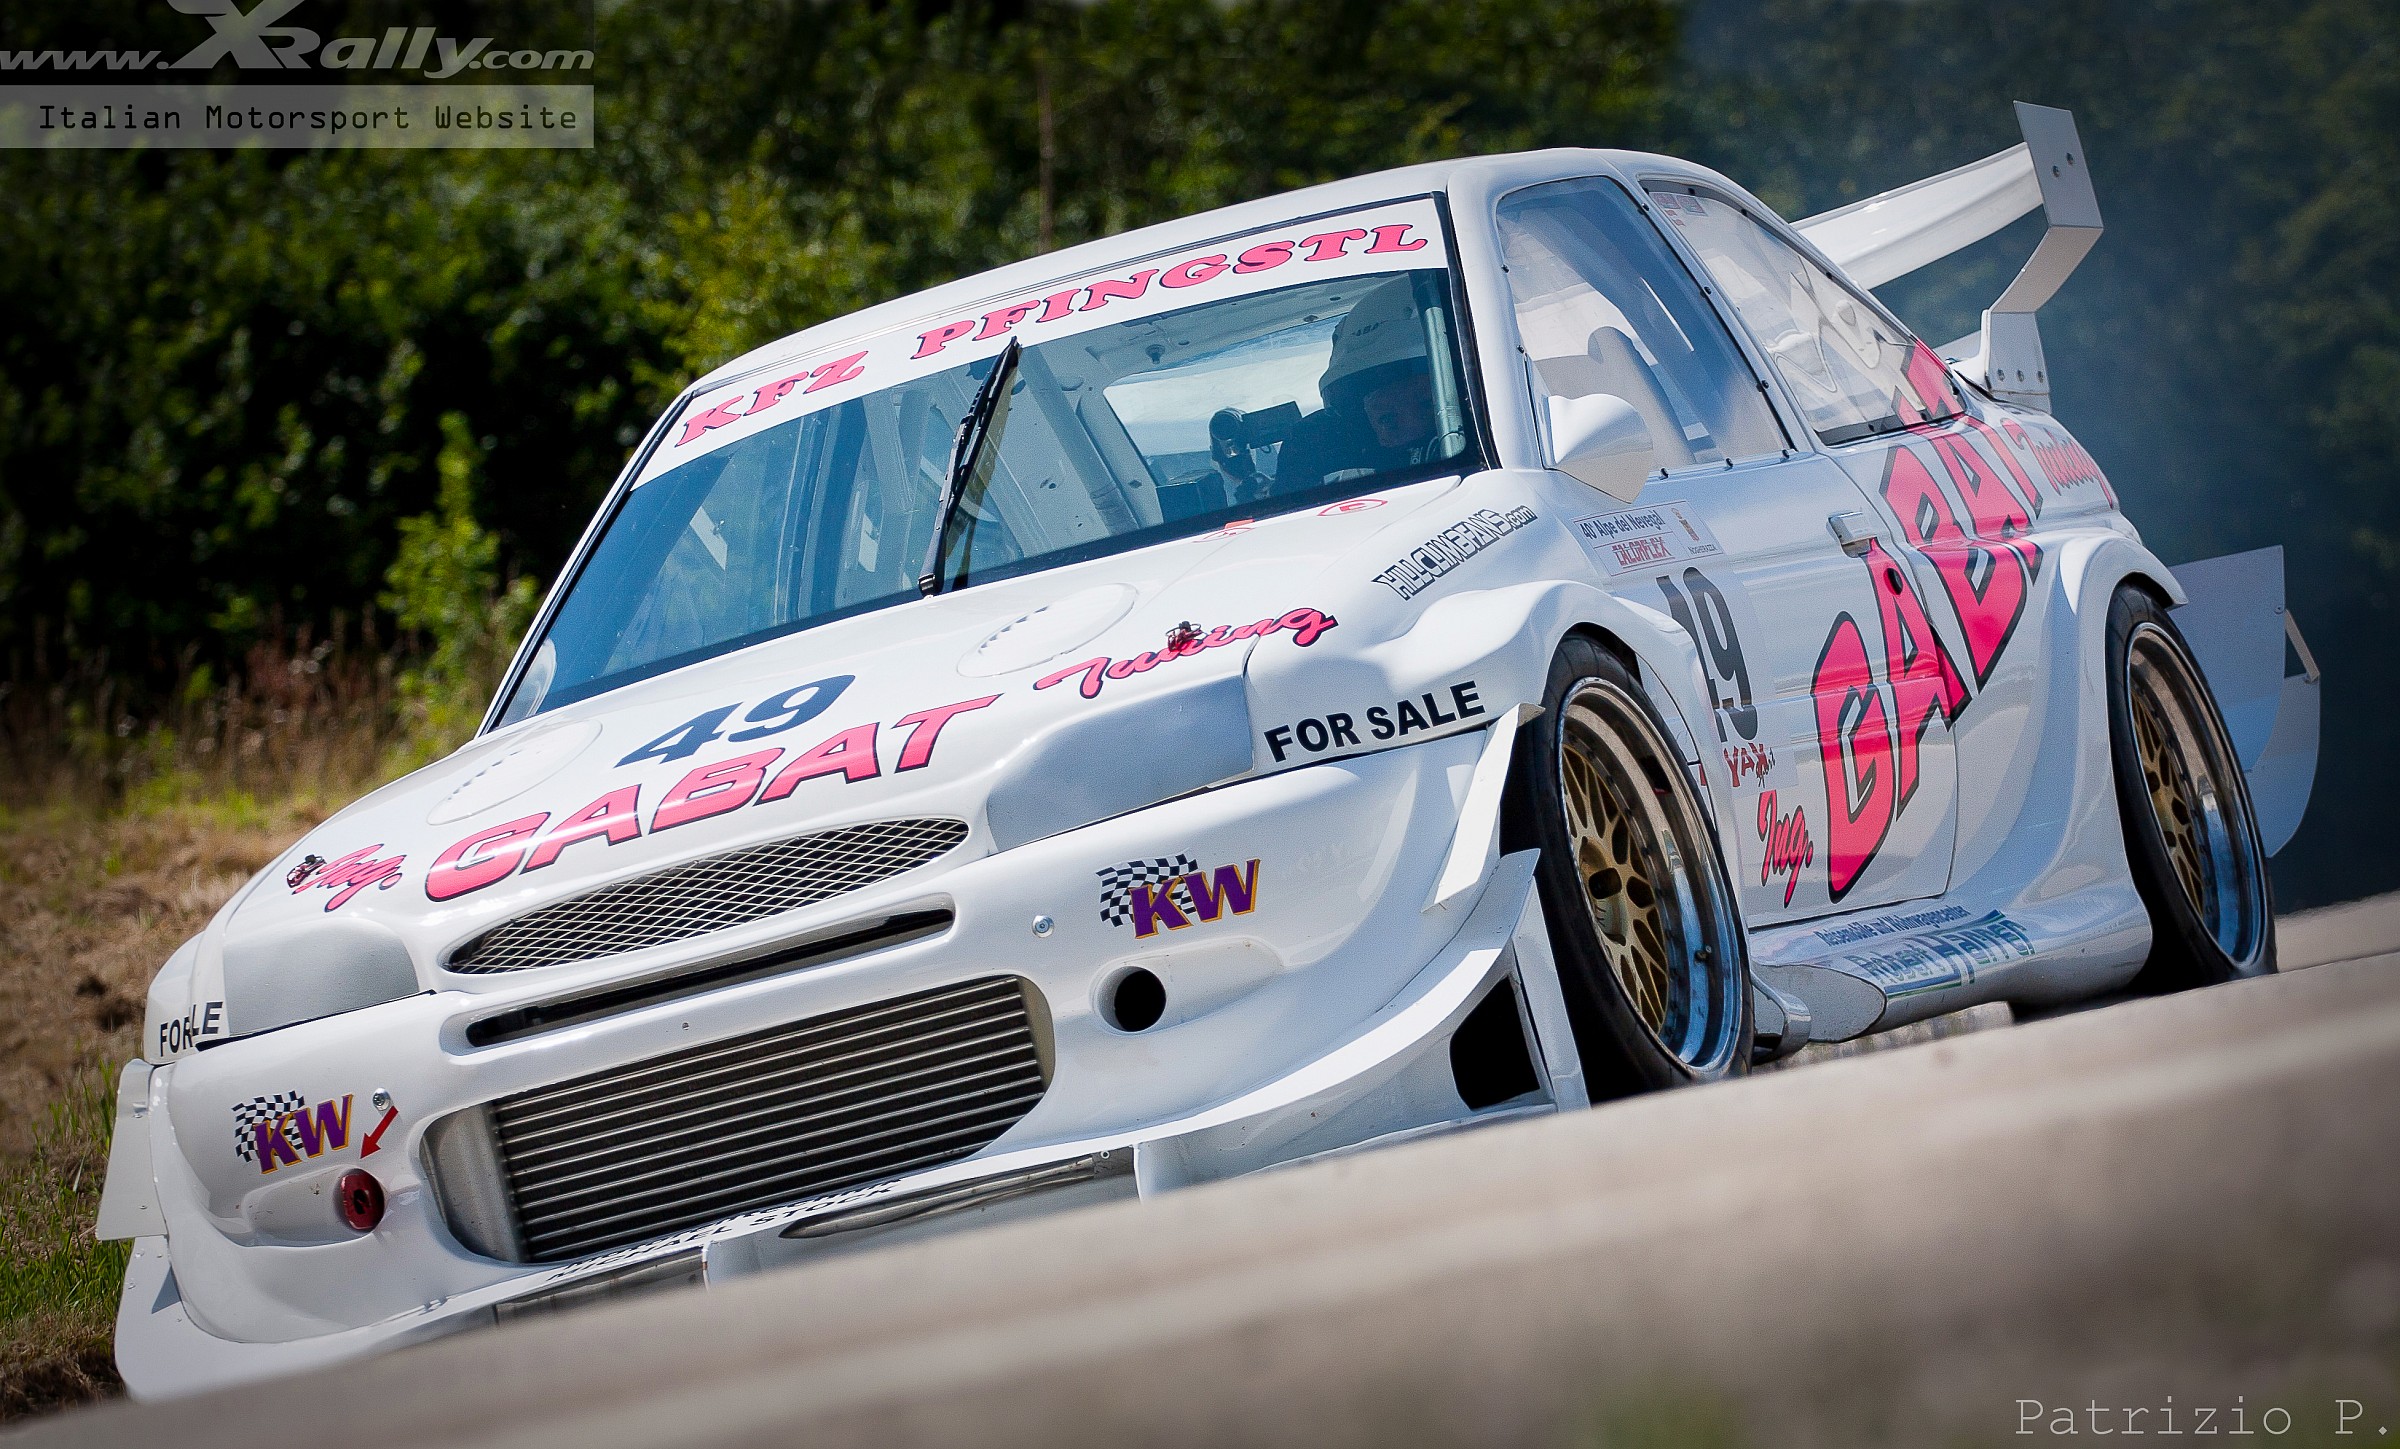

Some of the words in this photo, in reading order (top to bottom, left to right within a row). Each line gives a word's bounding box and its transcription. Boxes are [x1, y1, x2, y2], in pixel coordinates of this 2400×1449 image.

[674, 350, 869, 448] KFZ
[909, 224, 1429, 361] PFINGSTL
[1595, 516, 1619, 539] Alpe
[1614, 512, 1632, 532] del
[1757, 789, 1814, 909] Ing.
[1810, 337, 2043, 905] GABAT
[424, 692, 1005, 902] GABAT
[1033, 607, 1338, 699] Tuning
[613, 673, 855, 768] 49
[1264, 712, 1361, 763] FOR
[1366, 681, 1486, 740] SALE
[1128, 858, 1261, 939] KW
[1843, 941, 1947, 984] Robert
[190, 1001, 223, 1036] LE
[252, 1093, 353, 1175] KW
[750, 1186, 893, 1226] STOCK
